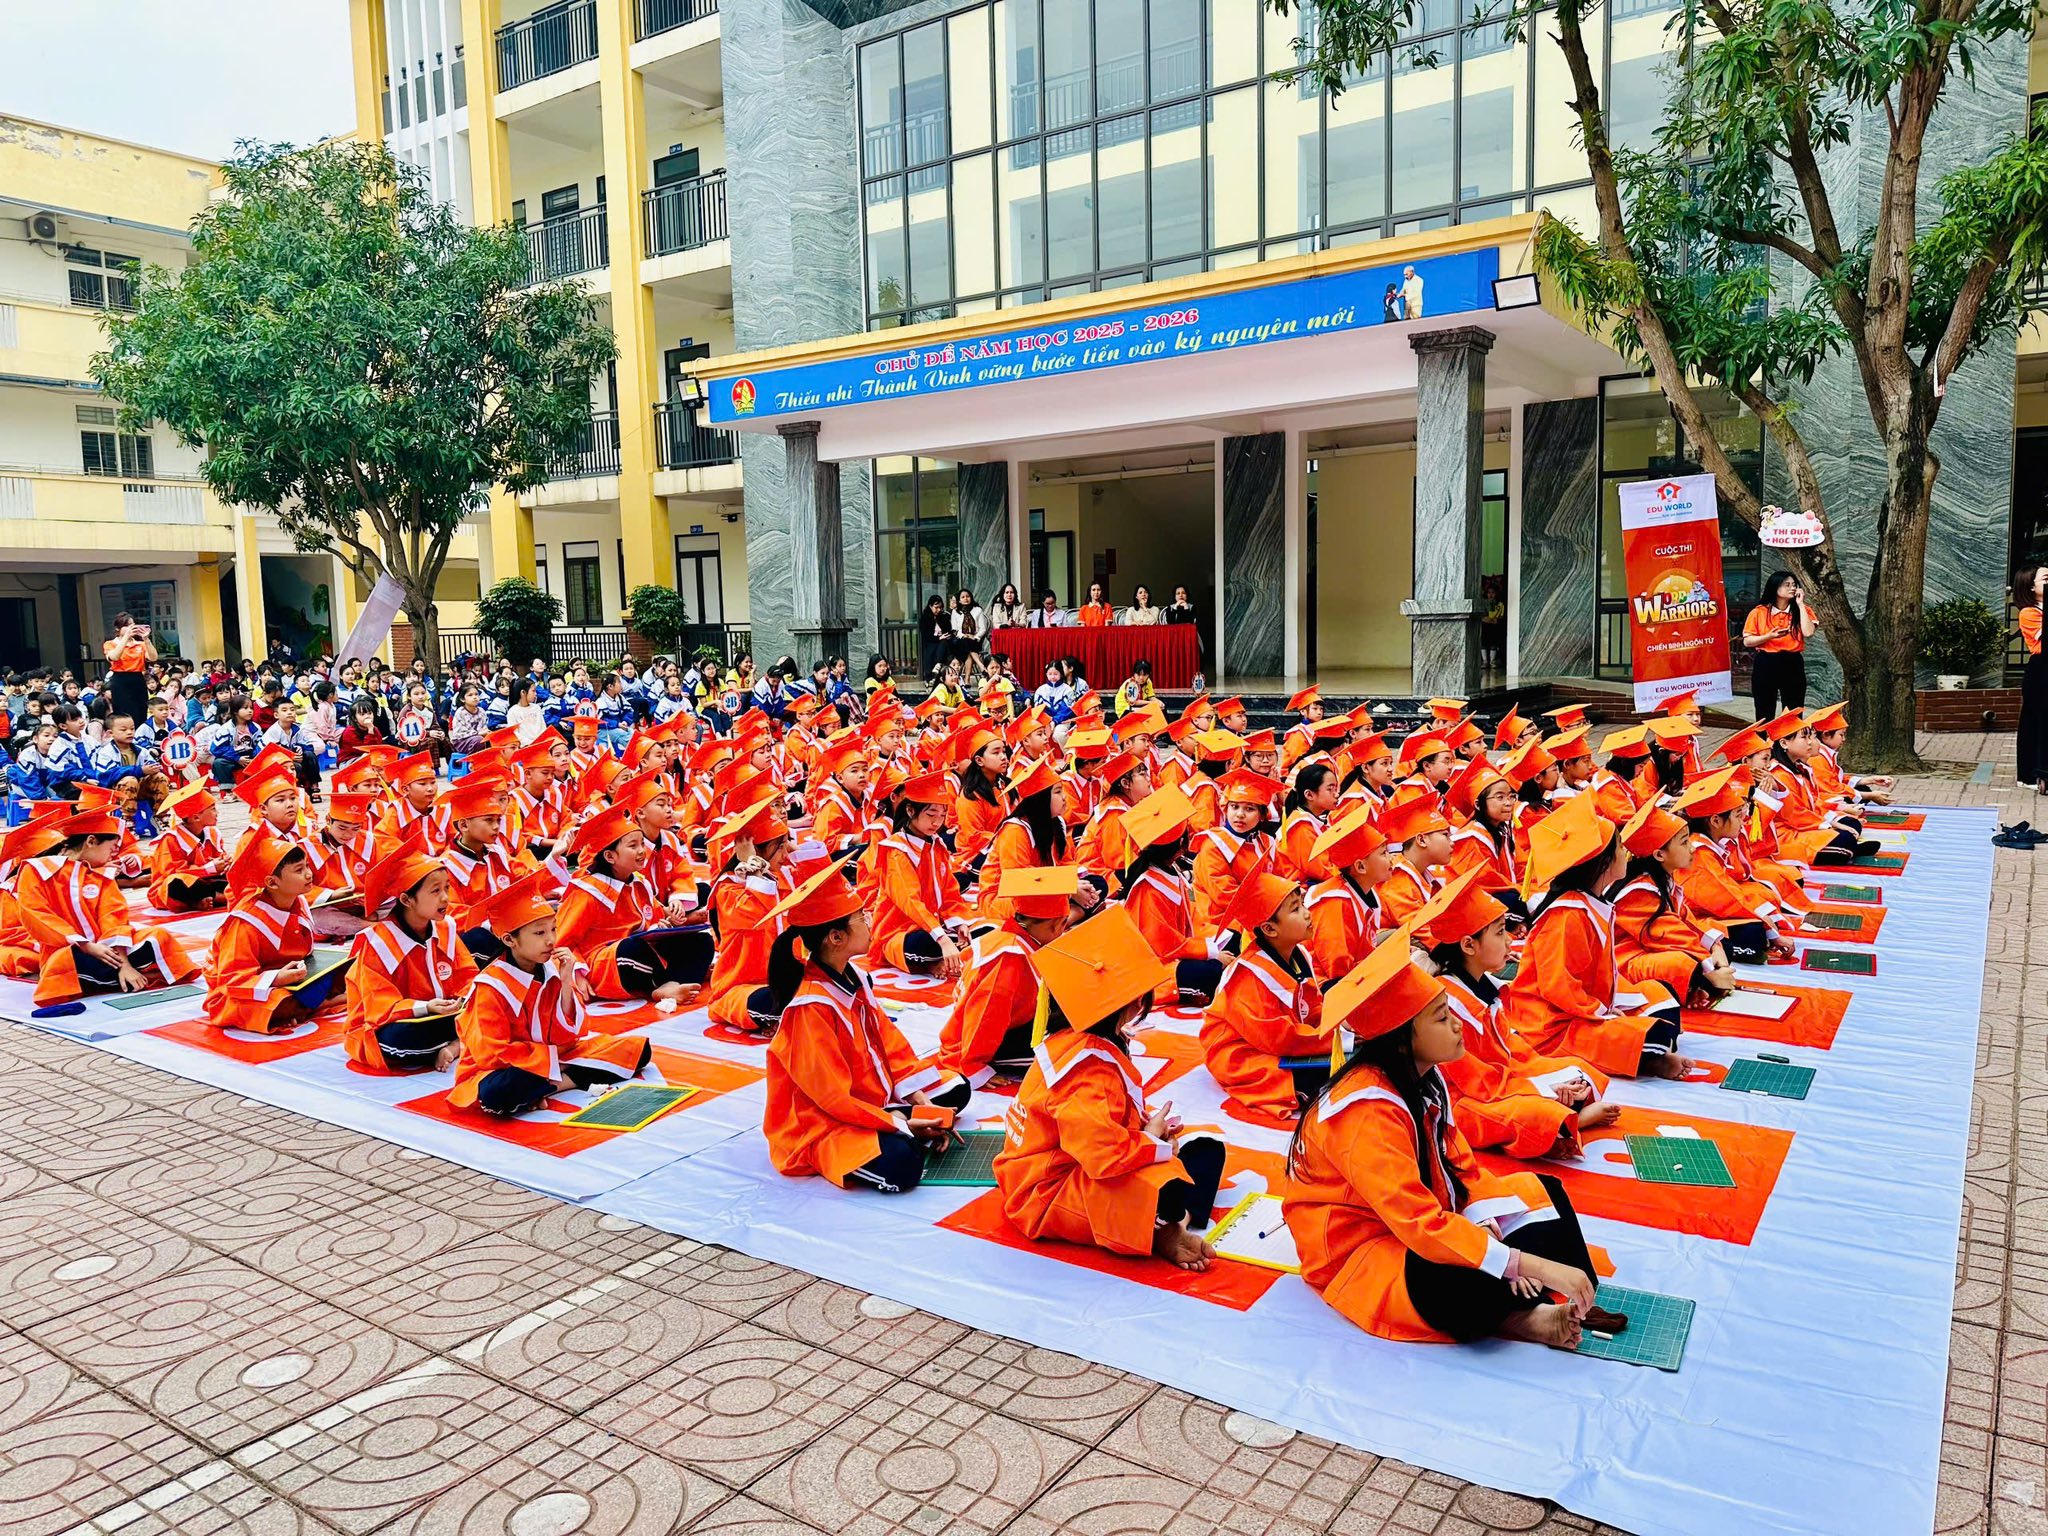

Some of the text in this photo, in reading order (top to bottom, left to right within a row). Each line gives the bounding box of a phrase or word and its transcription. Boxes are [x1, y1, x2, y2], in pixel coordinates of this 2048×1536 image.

[875, 350, 920, 375] CHỦ
[924, 344, 955, 367] ĐỀ
[960, 340, 1011, 361] NĂM
[1017, 330, 1068, 352] HỌC
[1073, 321, 1124, 343] 2025
[1144, 309, 1199, 332] 2026
[775, 306, 1356, 410] Thiếu nhi Thành Vinh vững bước tiến vào kỷ nguyên mới
[1665, 502, 1692, 512] WORLD
[1679, 543, 1692, 552] THI
[1634, 595, 1717, 624] WARRIORS
[1668, 641, 1684, 649] BINH
[1671, 683, 1695, 692] WORLD
[1696, 680, 1713, 688] VINH
[725, 696, 737, 708] 2B
[405, 722, 420, 736] 1A
[171, 743, 190, 759] 1B
